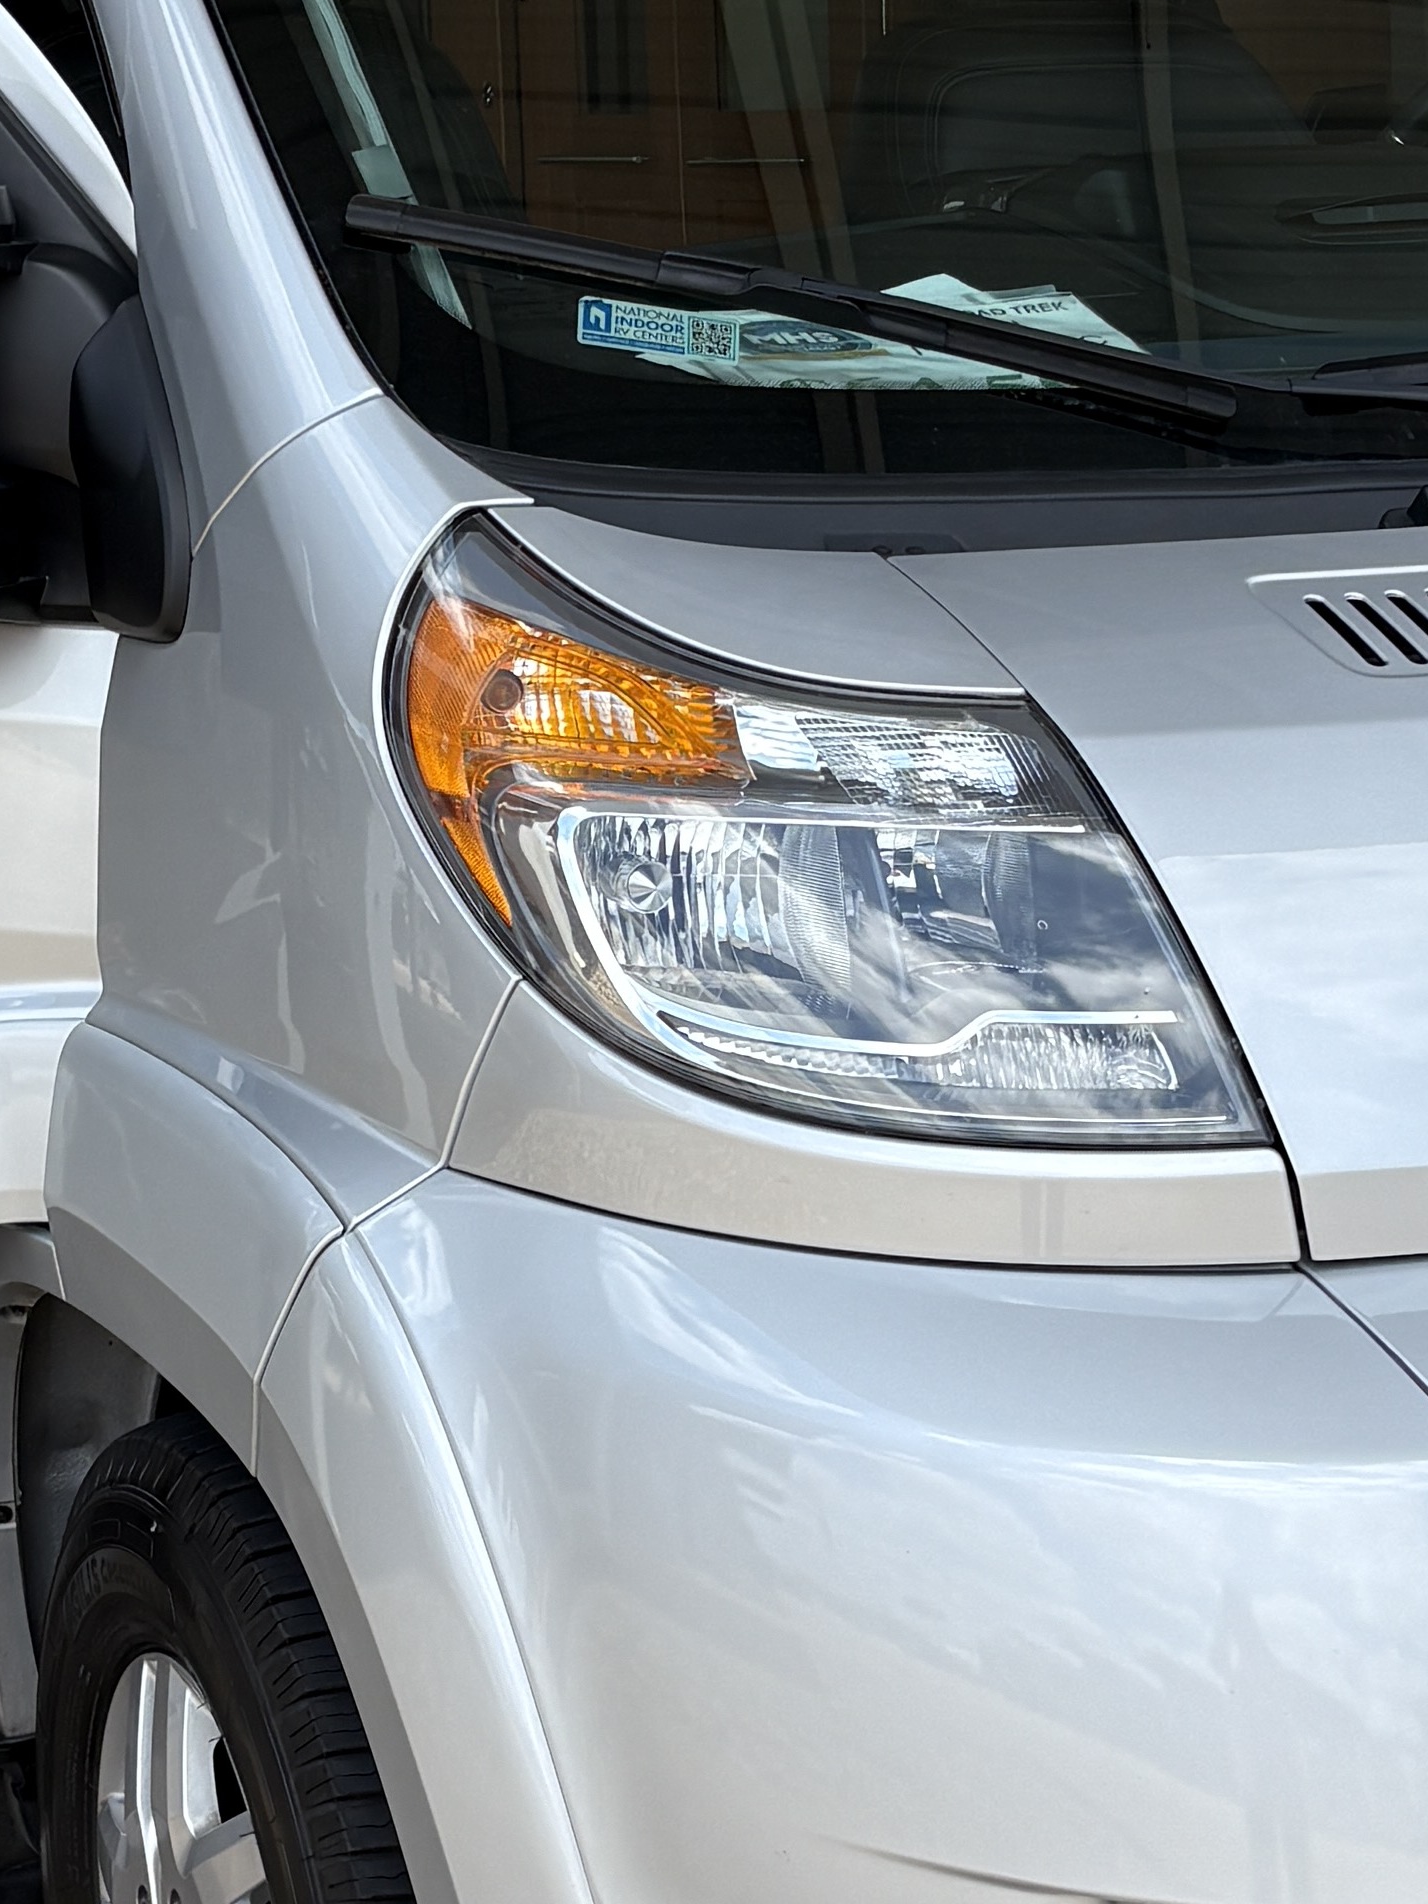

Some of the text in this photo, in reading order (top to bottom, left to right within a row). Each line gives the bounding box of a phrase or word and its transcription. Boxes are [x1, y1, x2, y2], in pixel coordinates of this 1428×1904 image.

[615, 304, 685, 325] NATIONAL
[1009, 301, 1069, 315] TREK
[615, 315, 686, 336] INDOOR
[614, 326, 630, 336] RV
[633, 329, 686, 346] CENTERS
[742, 331, 839, 345] MHS
